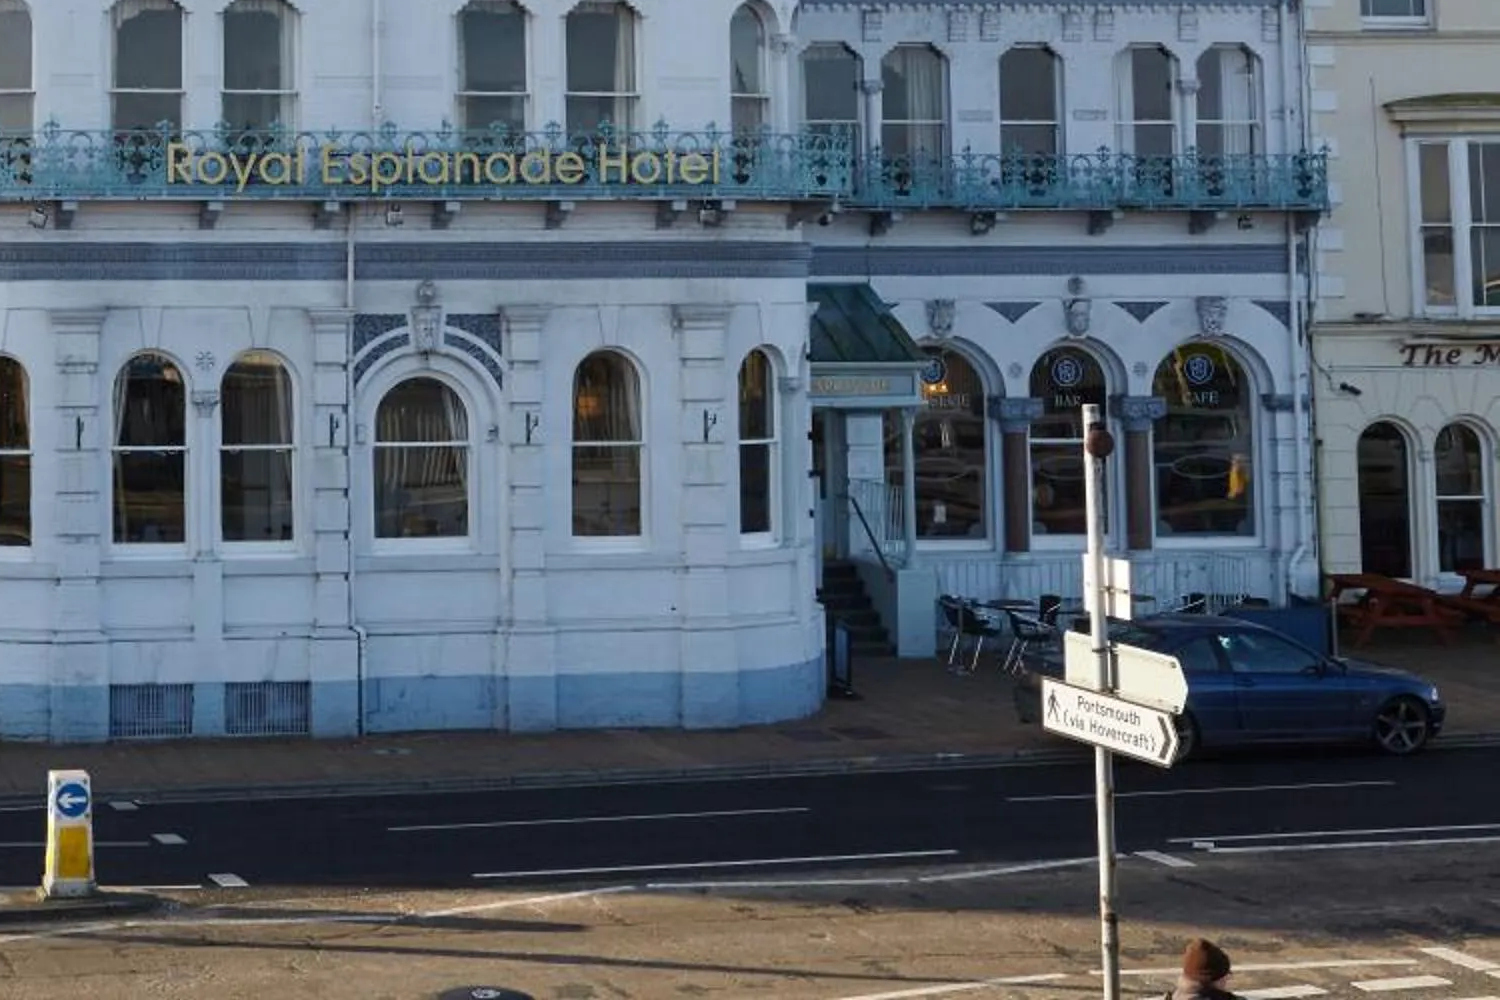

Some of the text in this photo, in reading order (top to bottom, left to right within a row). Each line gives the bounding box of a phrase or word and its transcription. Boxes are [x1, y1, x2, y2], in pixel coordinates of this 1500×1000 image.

[167, 140, 719, 193] Royal Esplanade Hotel
[1399, 343, 1462, 367] The
[1063, 707, 1157, 752] (via Hovercraft)
[1077, 695, 1141, 726] Portsmouth
